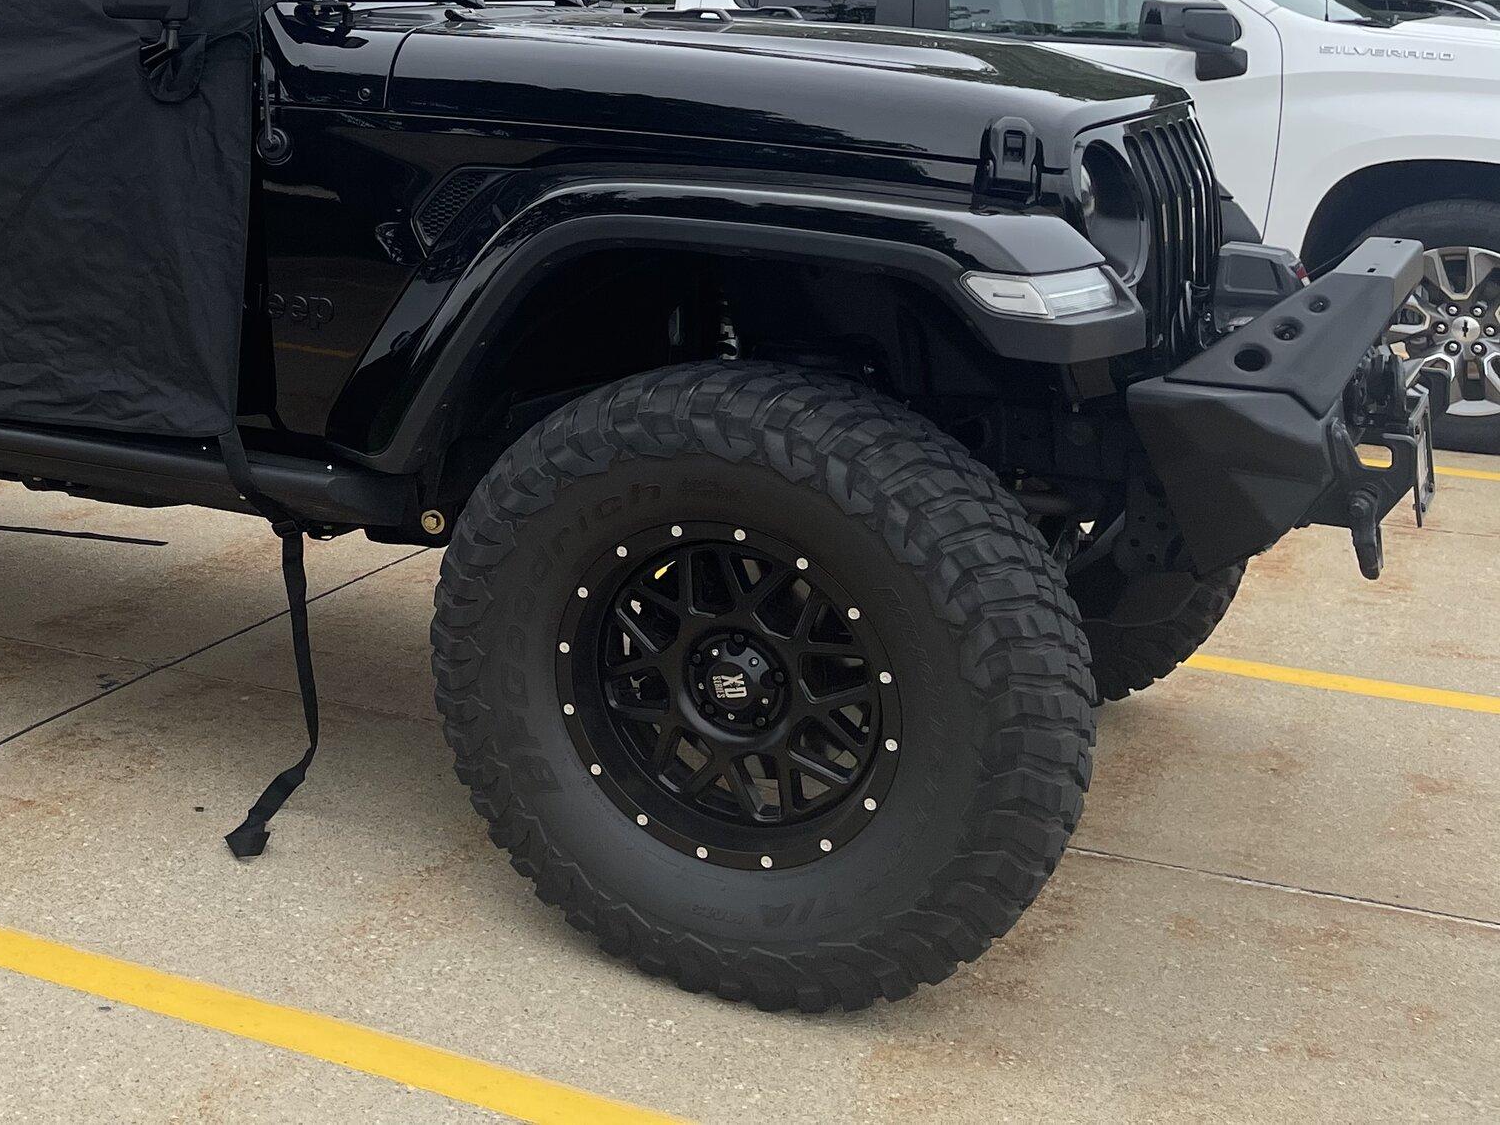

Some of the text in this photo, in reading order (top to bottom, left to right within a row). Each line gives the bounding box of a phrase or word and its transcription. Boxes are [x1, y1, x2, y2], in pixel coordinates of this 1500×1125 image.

[1319, 45, 1455, 61] SILVERADO
[712, 675, 726, 699] SERIES
[720, 673, 747, 698] XD
